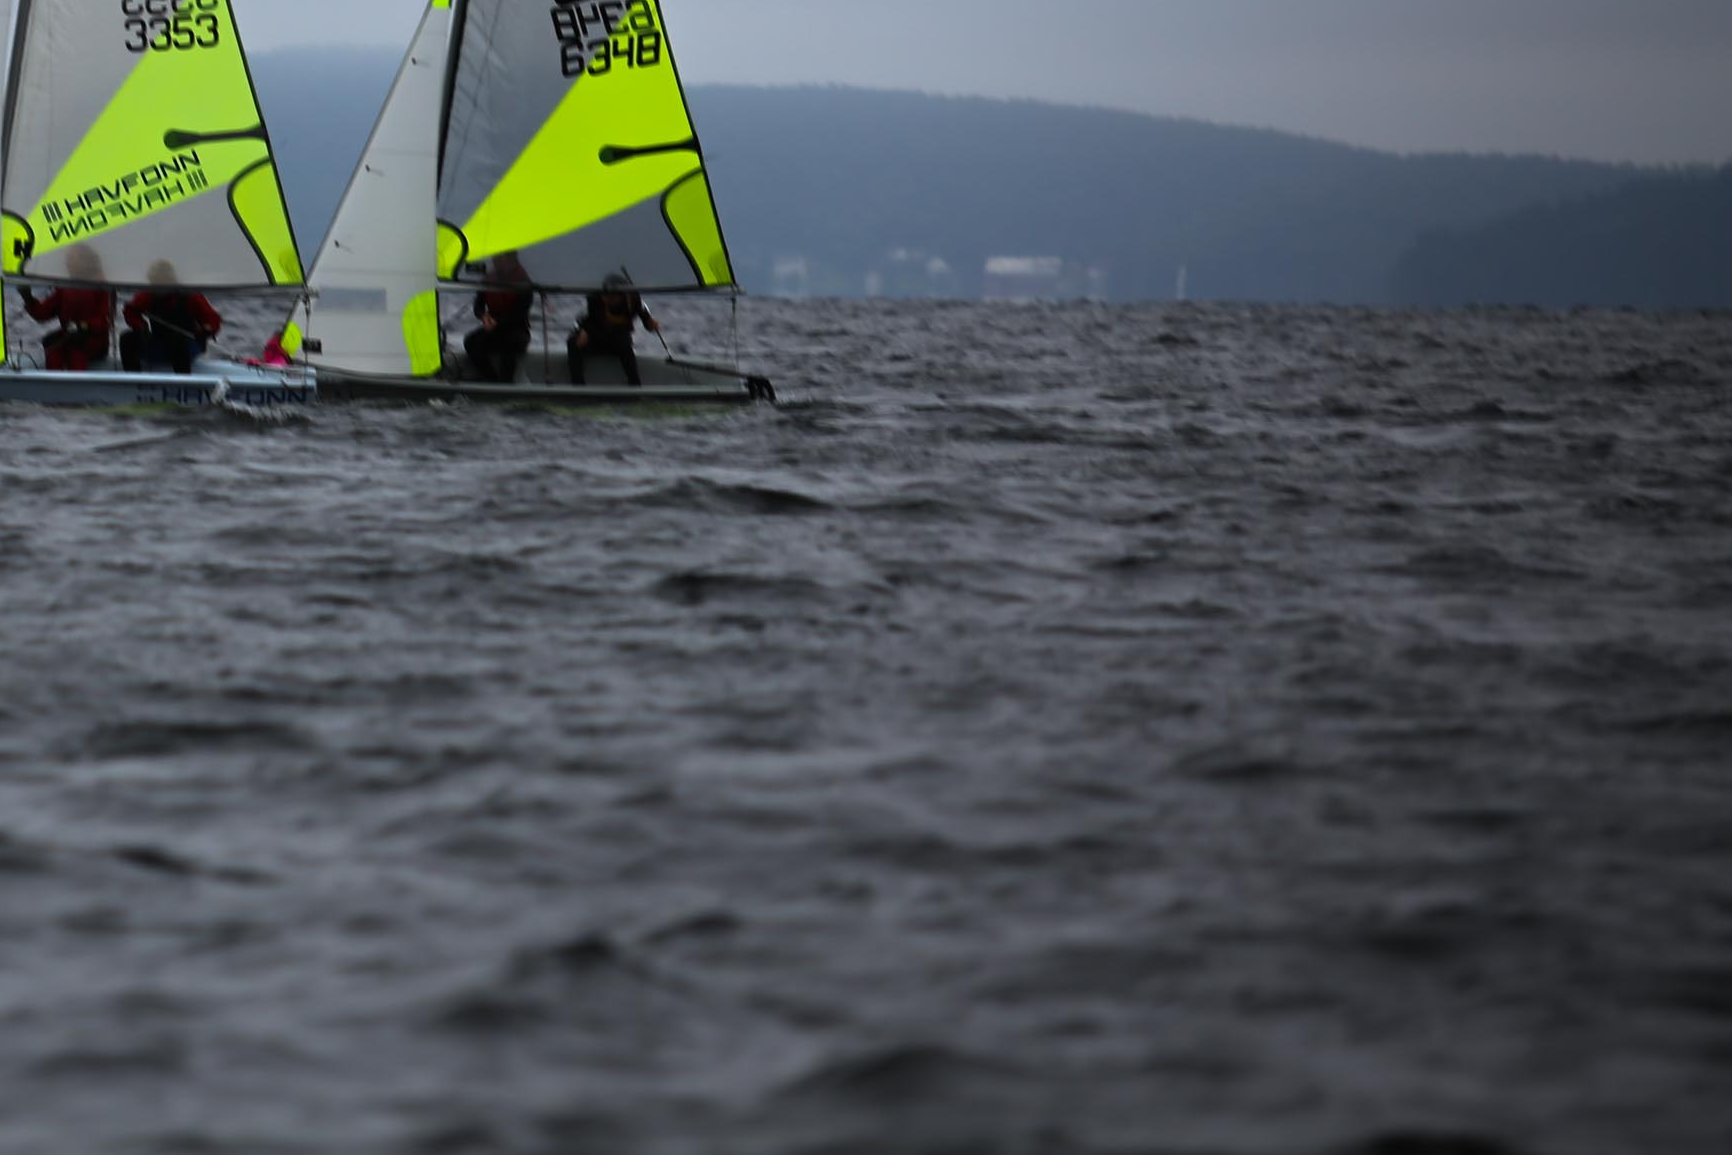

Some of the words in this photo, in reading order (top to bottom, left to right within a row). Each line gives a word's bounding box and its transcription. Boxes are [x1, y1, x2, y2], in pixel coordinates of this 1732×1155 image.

[125, 13, 219, 52] 3353
[561, 30, 661, 78] 6348
[64, 149, 201, 216] HAVFONN
